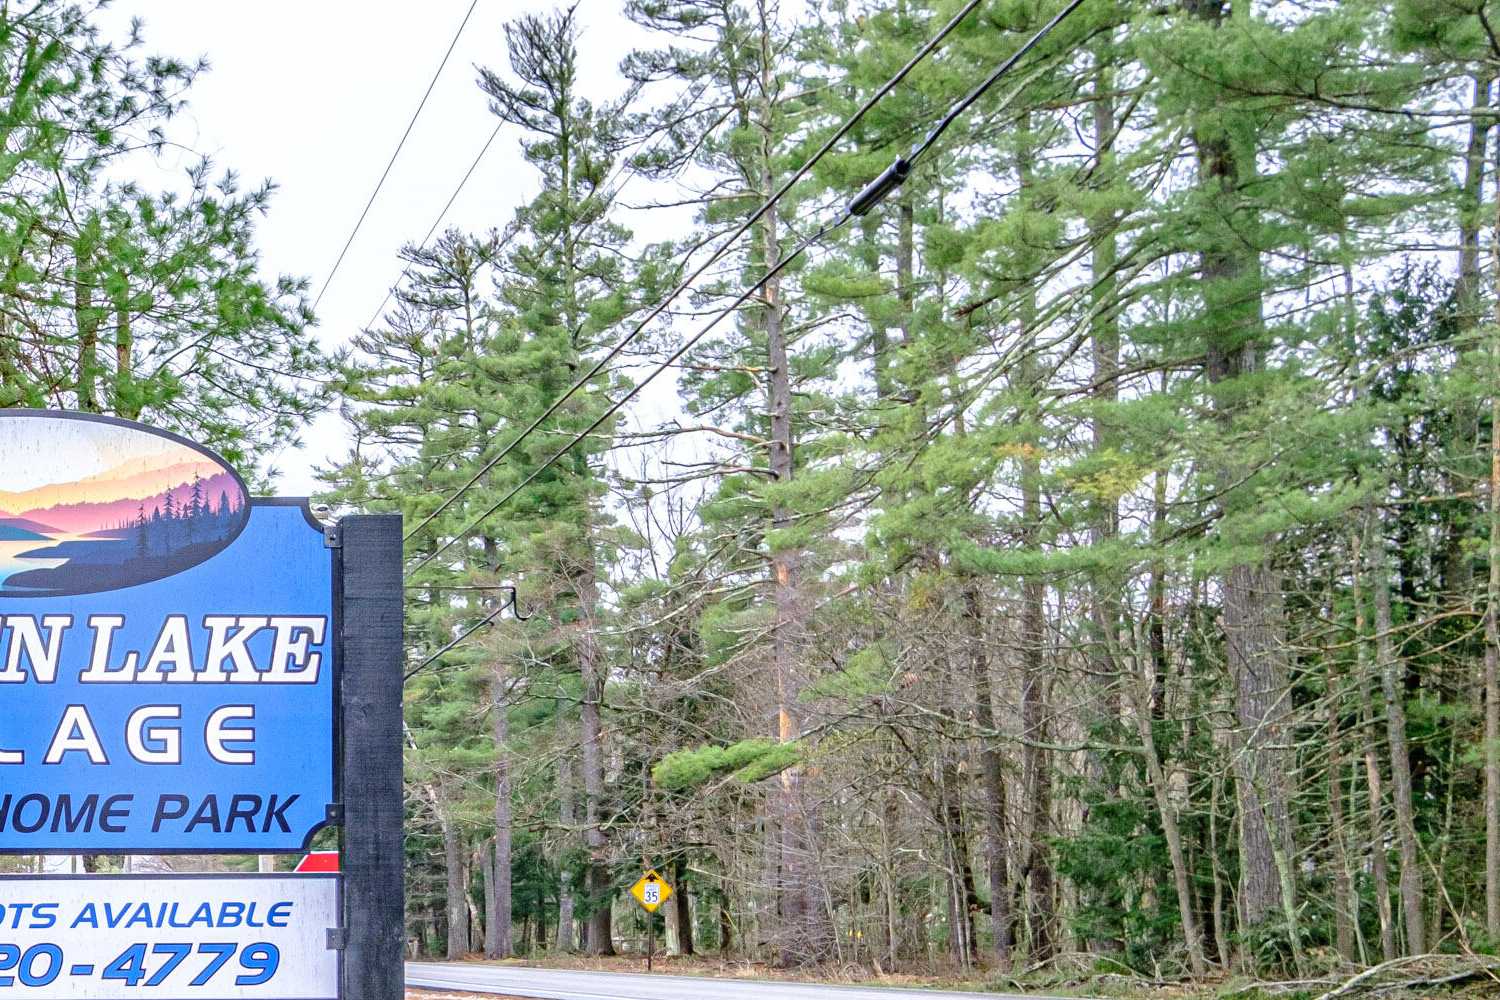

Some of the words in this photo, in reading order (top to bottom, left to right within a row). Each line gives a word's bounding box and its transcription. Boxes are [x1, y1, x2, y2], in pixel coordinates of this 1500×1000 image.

[79, 613, 328, 684] LAKE
[151, 793, 300, 834] PARK
[645, 891, 658, 903] 35
[70, 901, 294, 929] AVAILABLE
